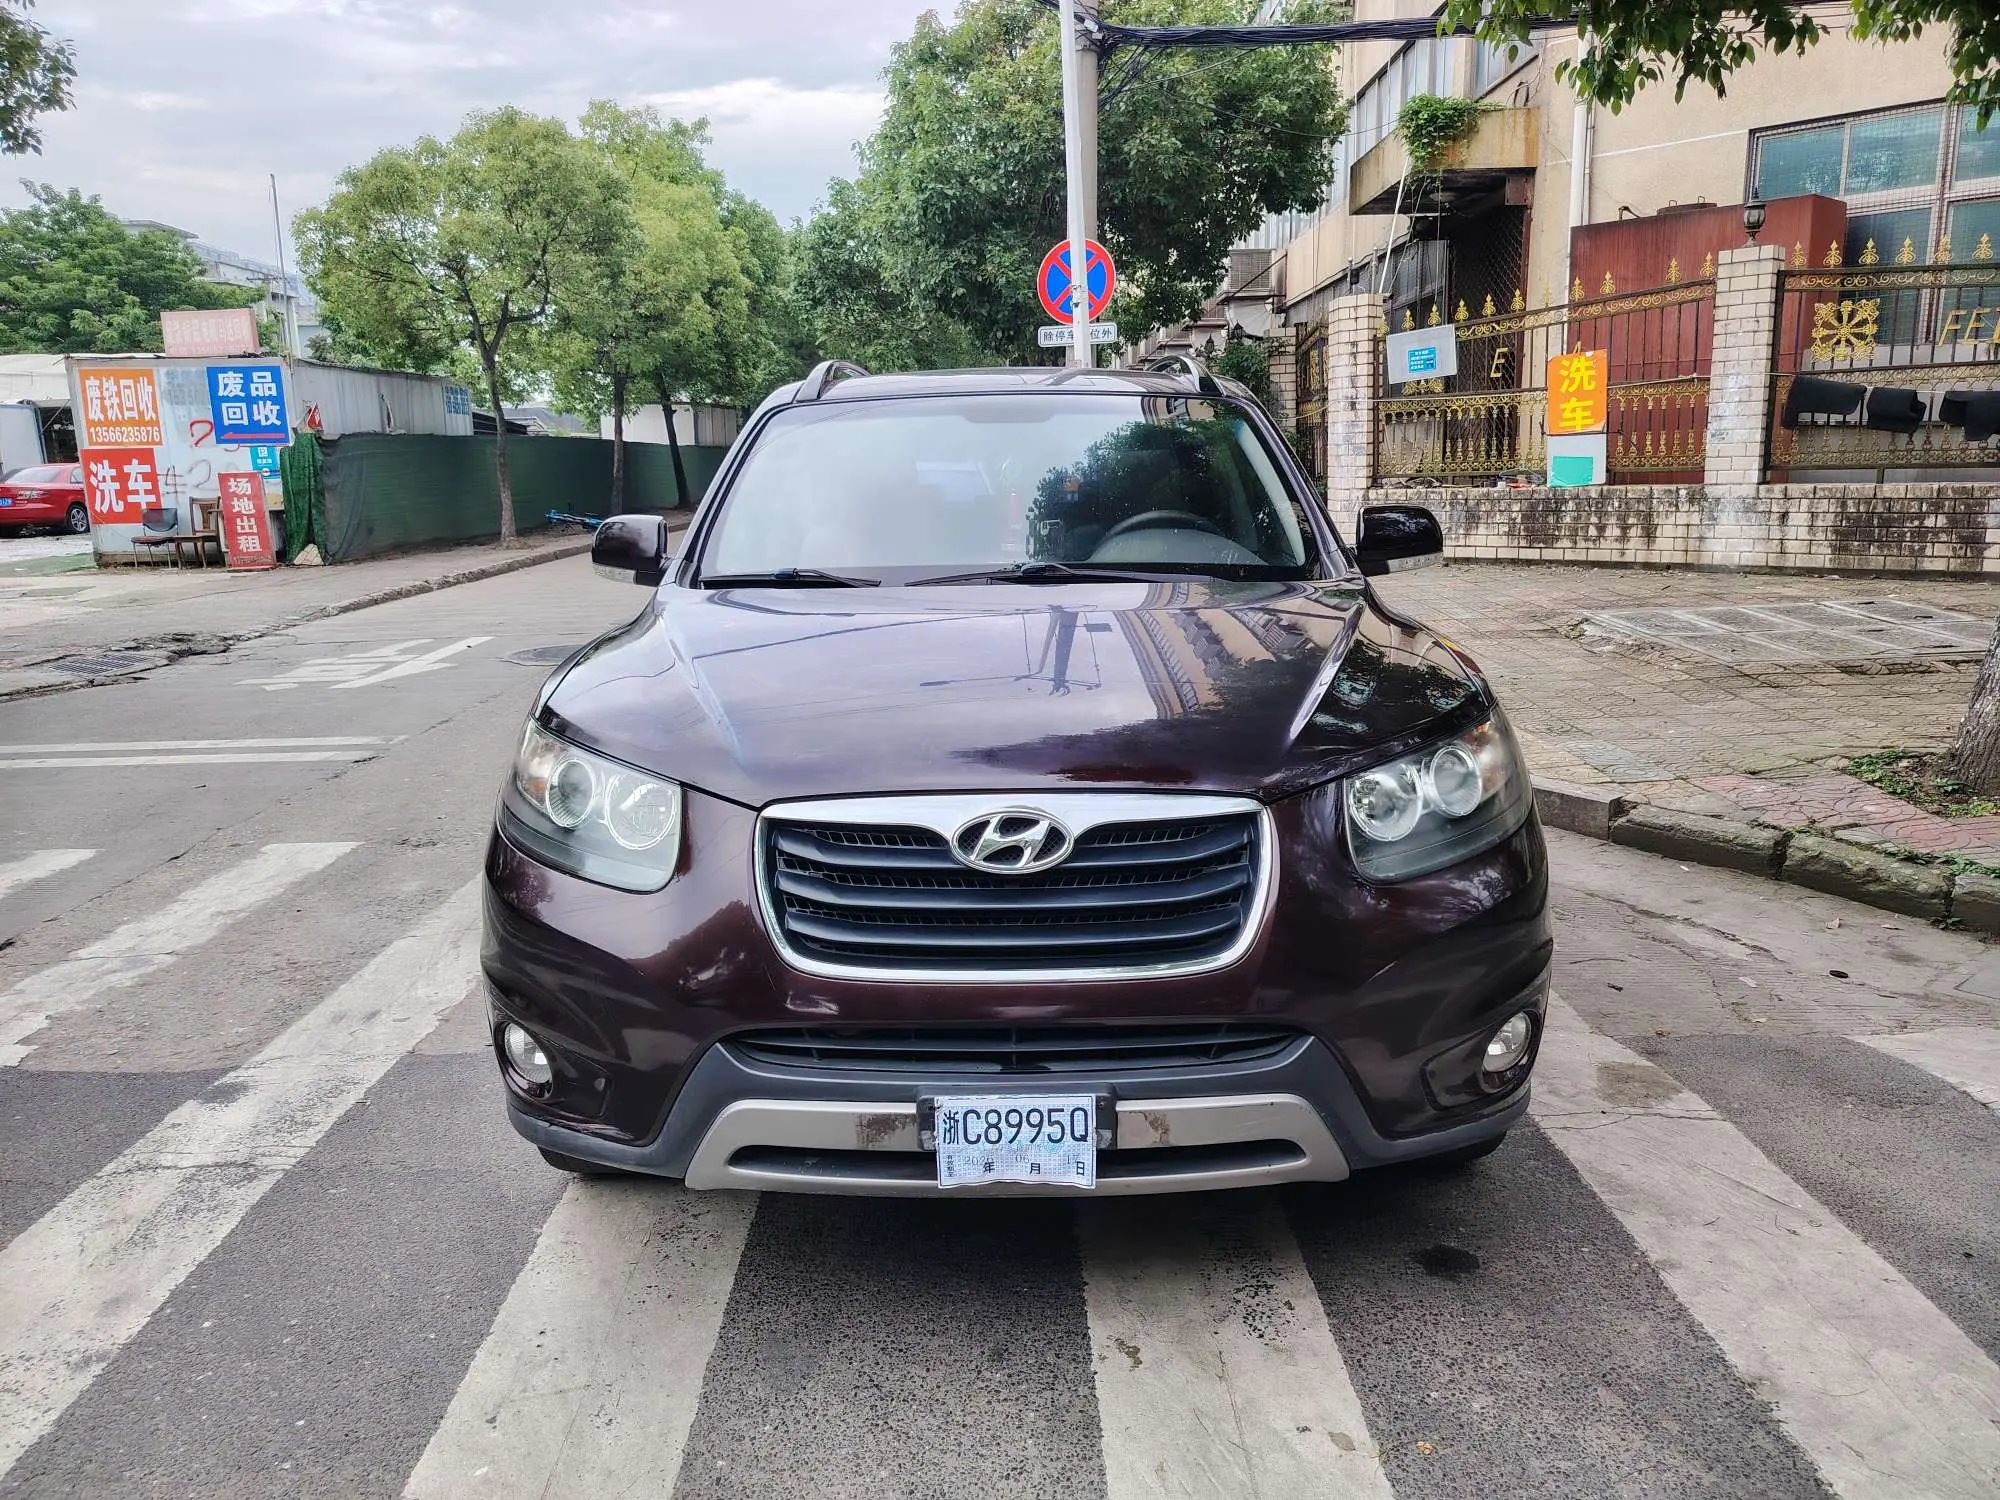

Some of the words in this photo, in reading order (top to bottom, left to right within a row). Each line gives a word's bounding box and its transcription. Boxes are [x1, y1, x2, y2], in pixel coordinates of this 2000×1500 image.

[86, 375, 156, 422] 废铁回收
[217, 371, 278, 397] 废品
[1559, 355, 1597, 431] 洗车
[221, 400, 281, 426] 回收
[90, 426, 161, 443] 13566235876
[90, 458, 156, 513] 洗车
[228, 478, 263, 552] 场地出租
[943, 1107, 1089, 1145] 浙C8995Q
